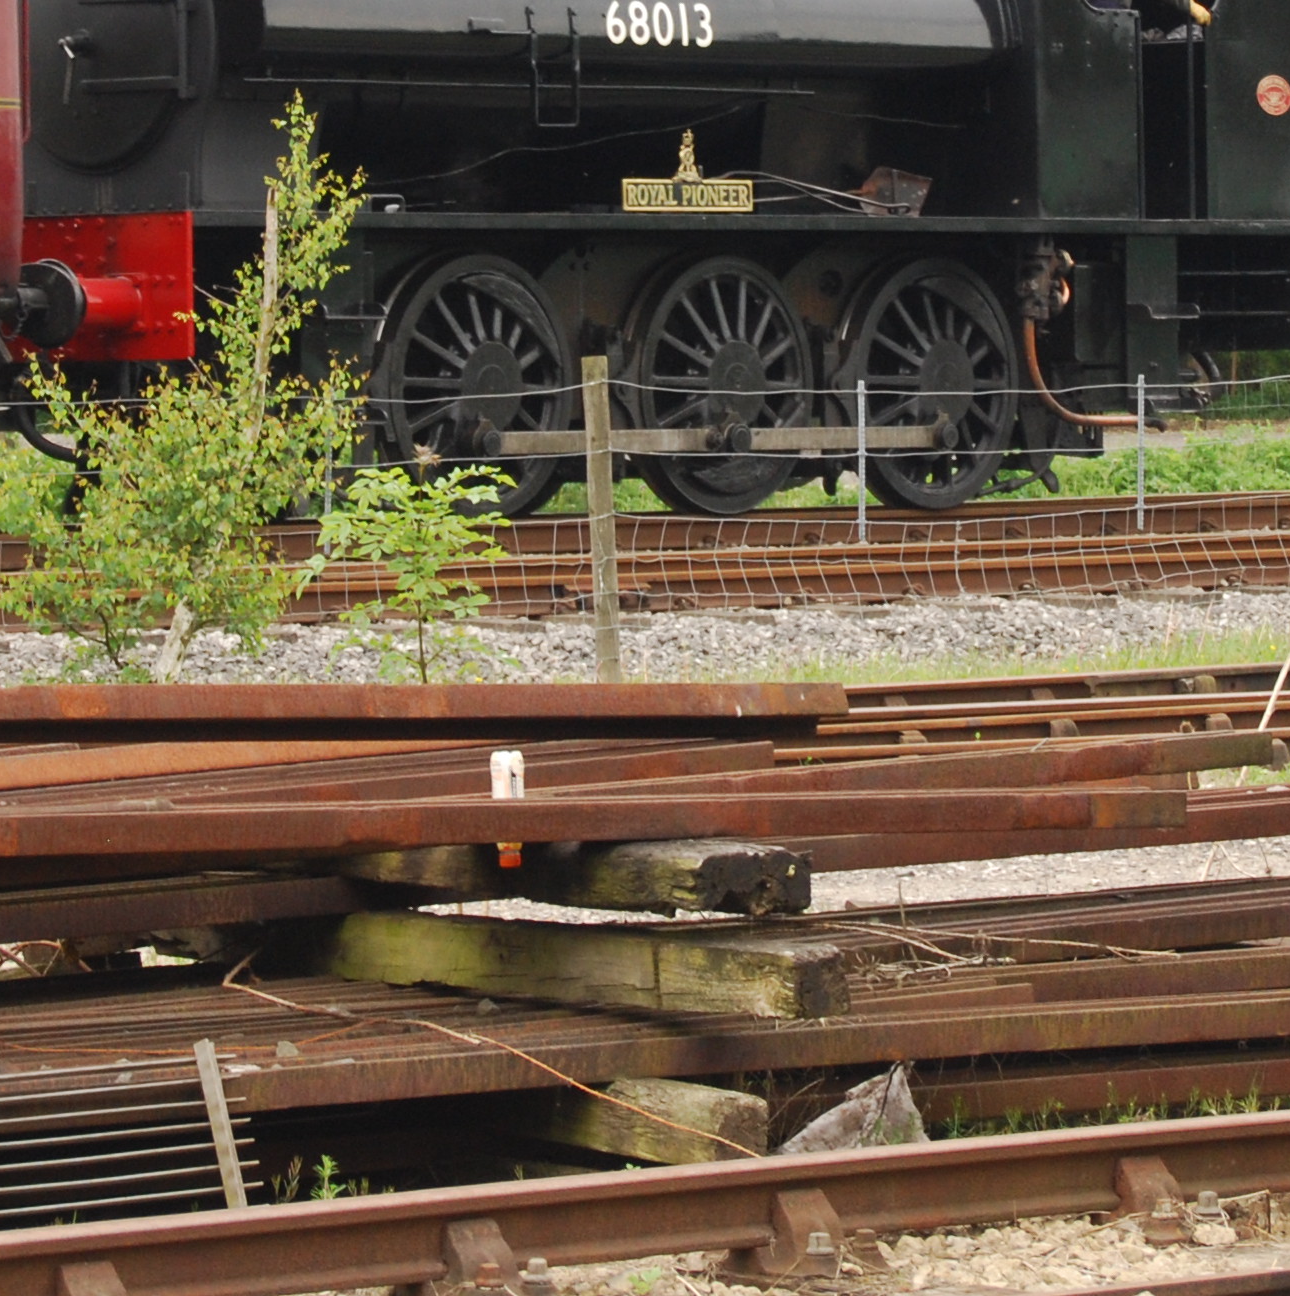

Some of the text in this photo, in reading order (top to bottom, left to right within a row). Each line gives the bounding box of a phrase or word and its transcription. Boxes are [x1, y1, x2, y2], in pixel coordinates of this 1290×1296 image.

[606, 0, 713, 48] 68013
[627, 184, 750, 207] ROYAL PIONEER
